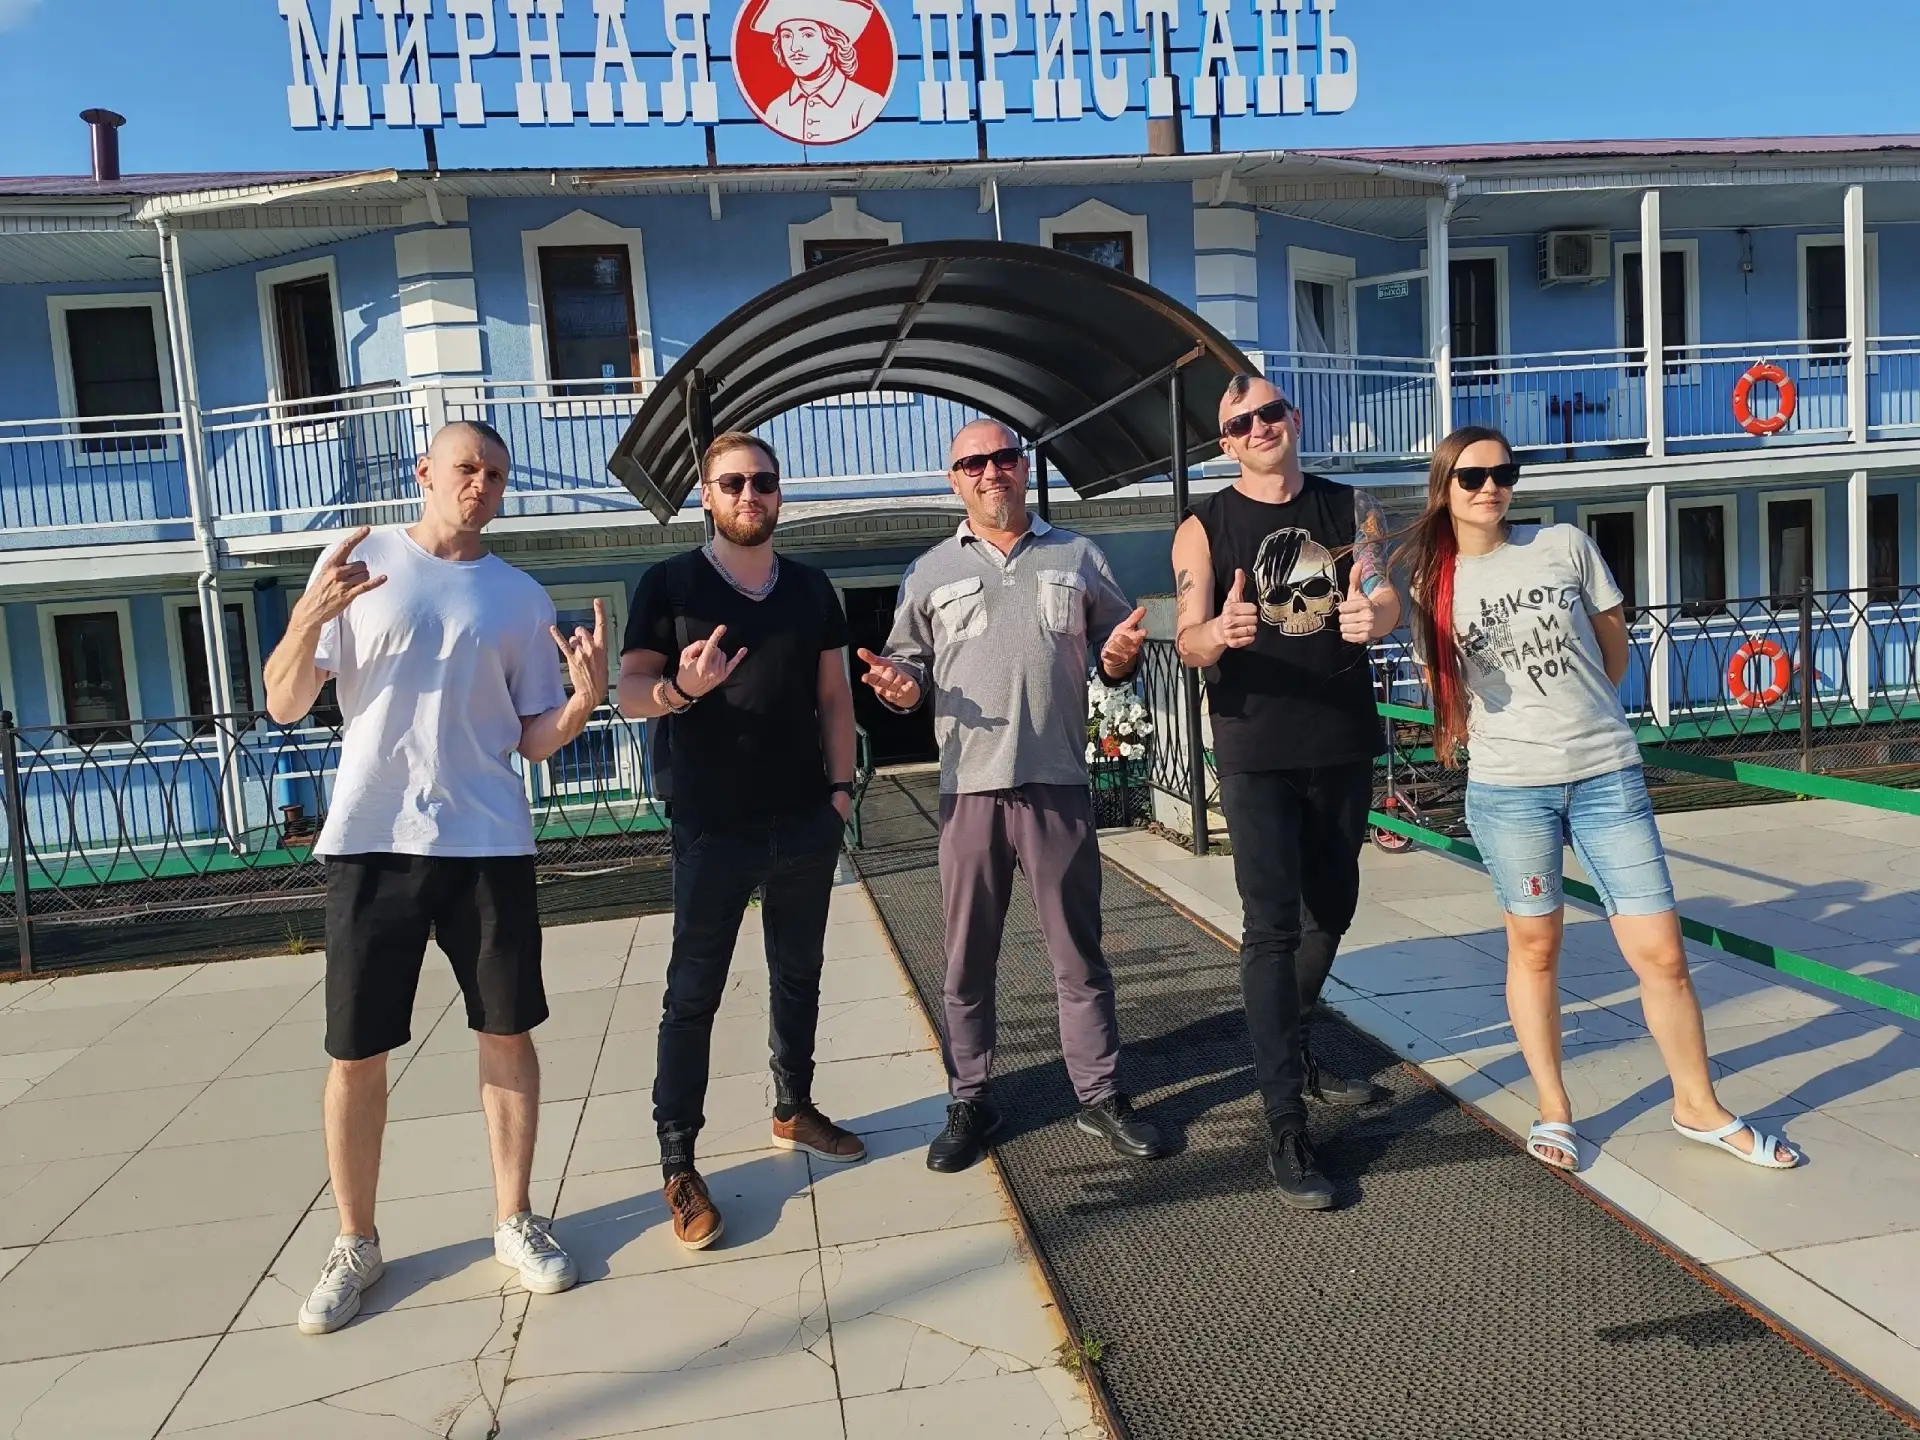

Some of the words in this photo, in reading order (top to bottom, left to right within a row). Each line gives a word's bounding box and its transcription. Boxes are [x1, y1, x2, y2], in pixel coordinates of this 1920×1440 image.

[279, 0, 719, 127] МИРНАЯ
[913, 0, 1357, 122] ПРИСТАНЬ
[1379, 287, 1406, 297] ВЫХОД
[1537, 614, 1560, 633] И
[1527, 655, 1580, 697] РОК
